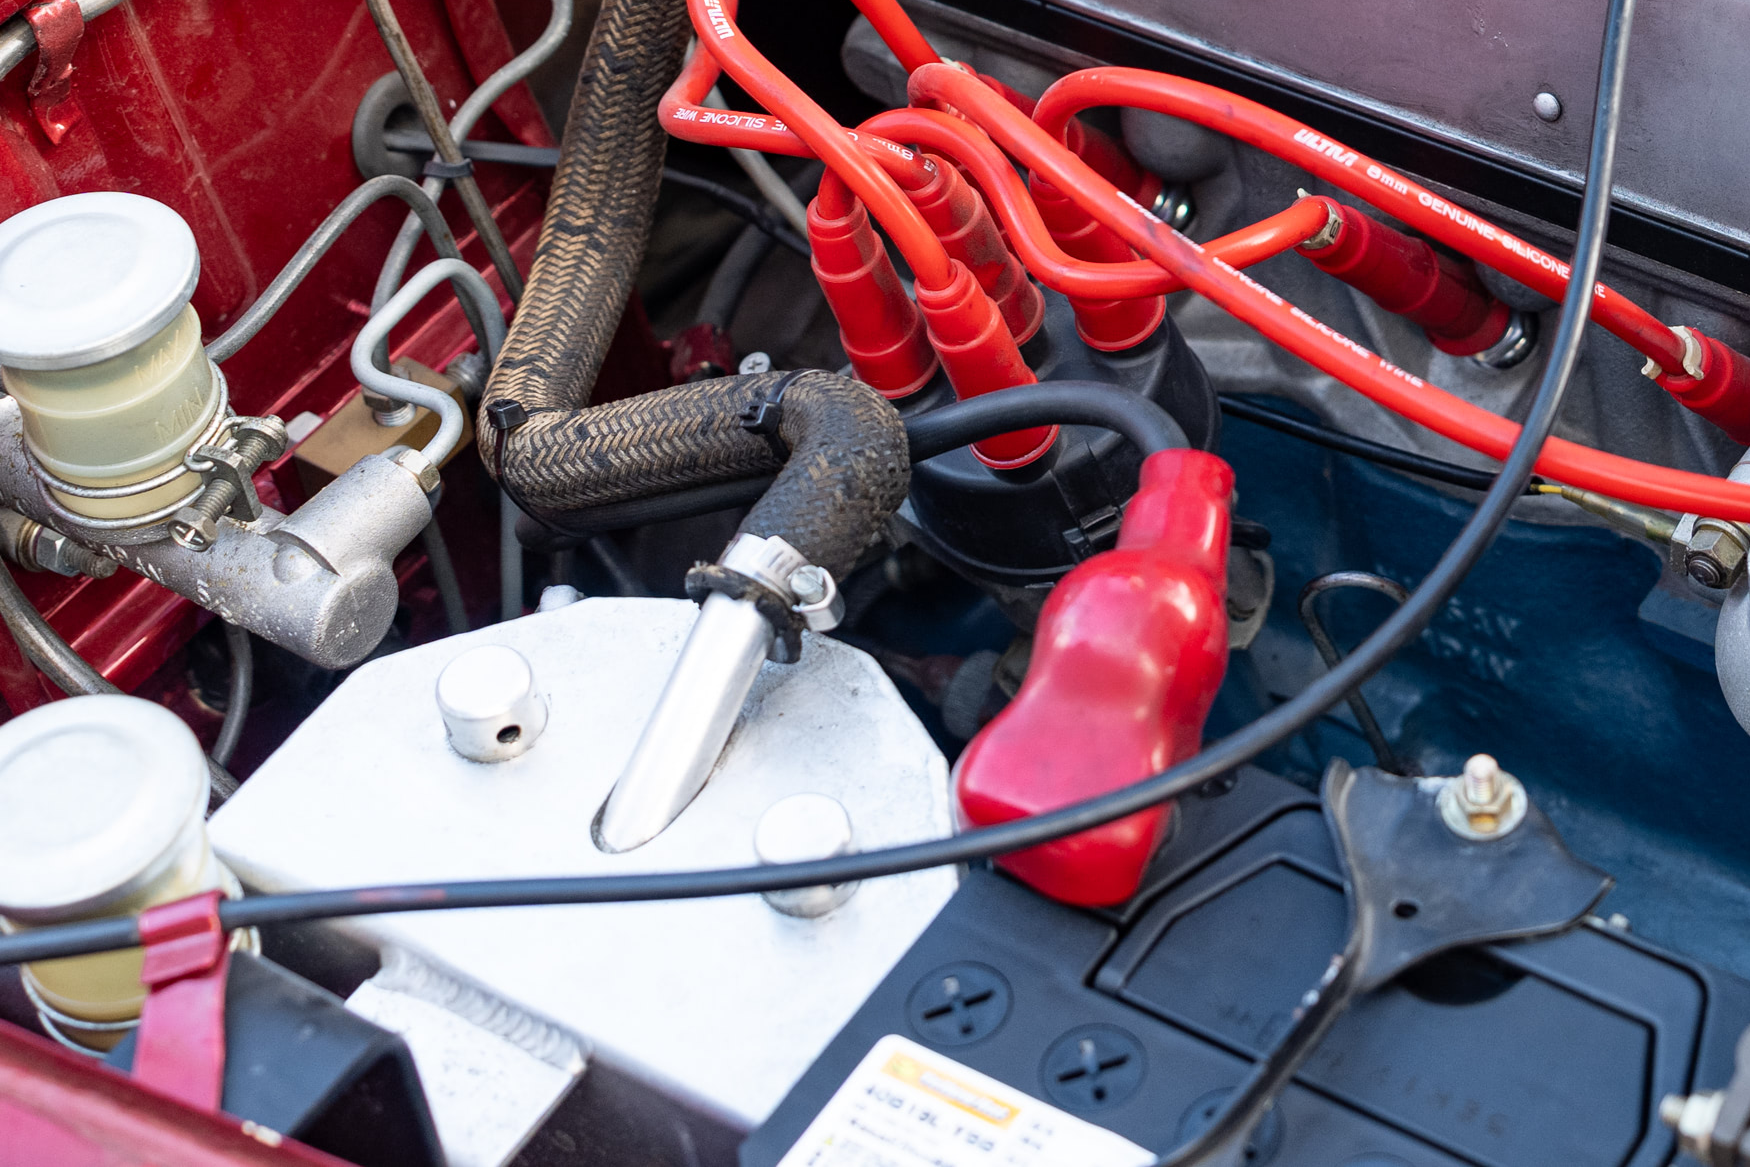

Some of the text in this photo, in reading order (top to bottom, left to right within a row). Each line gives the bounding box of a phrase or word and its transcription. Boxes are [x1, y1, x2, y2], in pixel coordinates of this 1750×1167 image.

[673, 107, 698, 121] WIRE
[700, 111, 767, 129] SILICONE
[1366, 165, 1409, 195] 8mm
[1418, 192, 1497, 241] GENUINE
[1500, 235, 1571, 280] SILICONE
